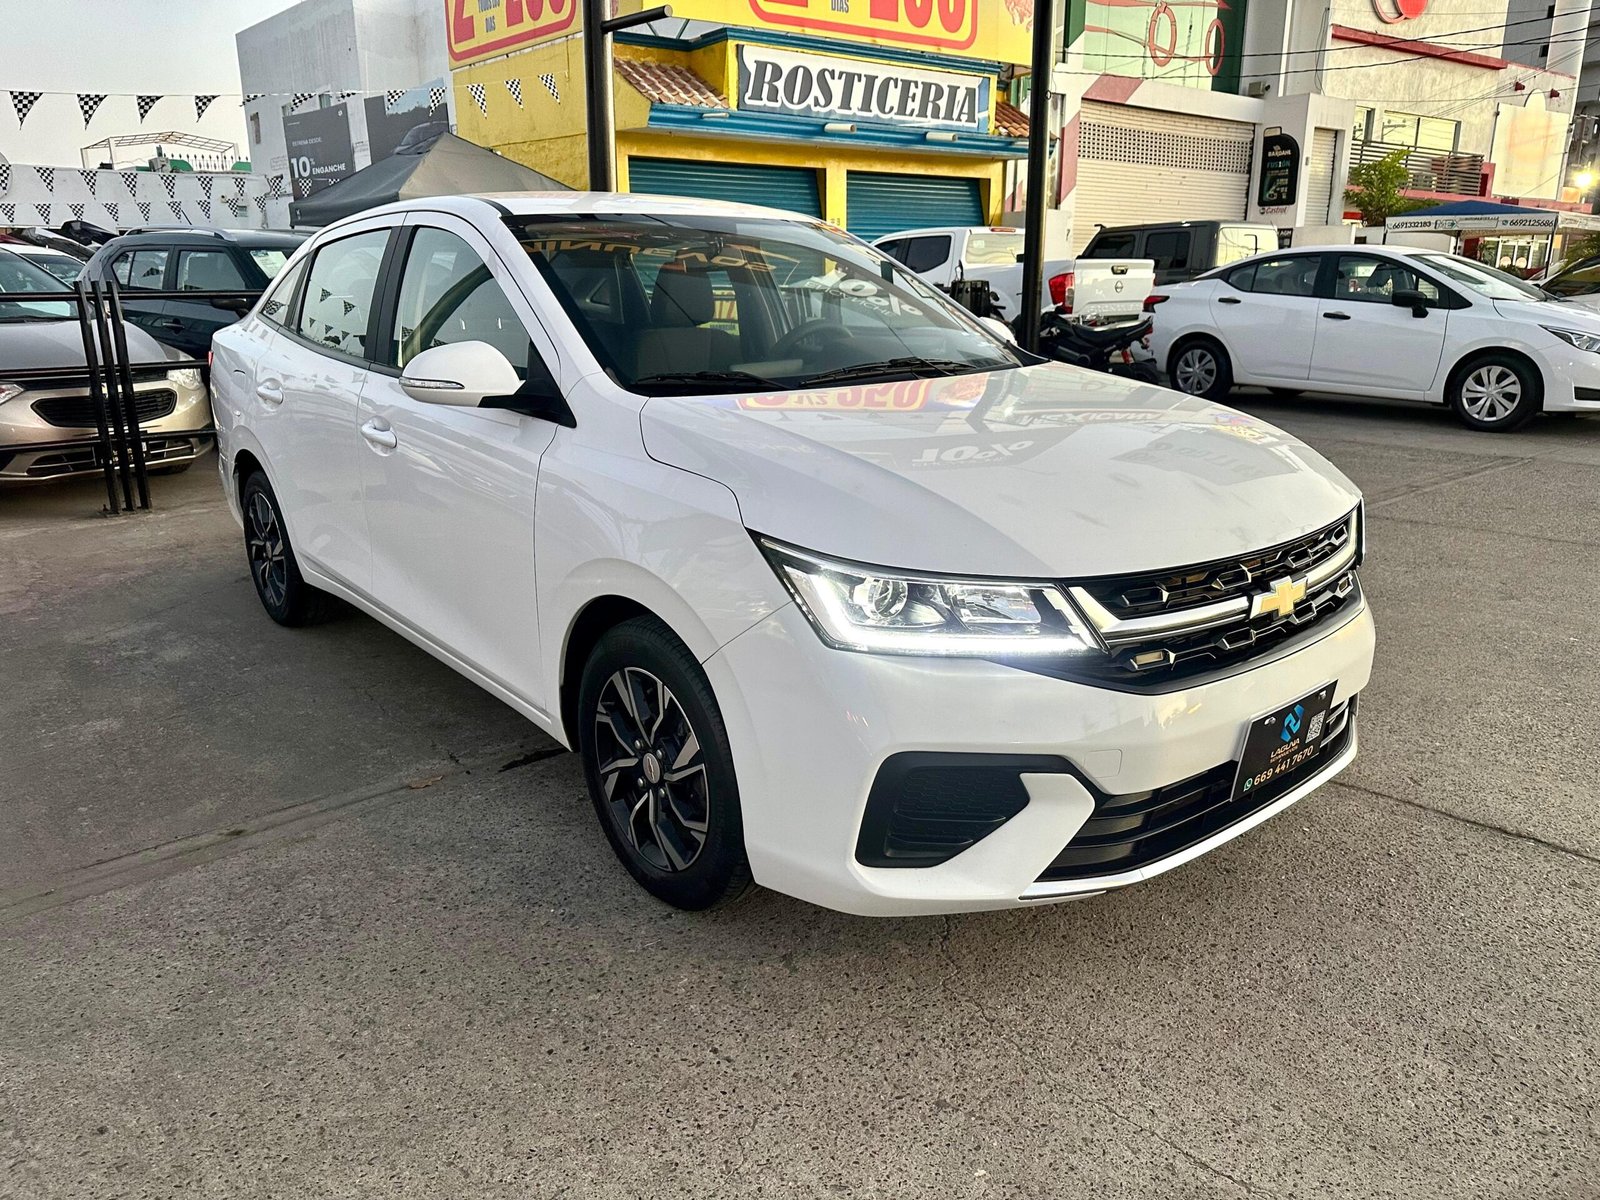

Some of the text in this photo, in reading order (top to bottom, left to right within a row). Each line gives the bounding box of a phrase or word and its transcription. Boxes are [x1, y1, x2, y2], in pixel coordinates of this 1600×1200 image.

[748, 60, 977, 123] ROSTICERIA
[312, 163, 346, 175] ENGANCHE
[1509, 218, 1554, 227] 6692125686
[1270, 738, 1299, 757] LAGUNA
[1254, 745, 1313, 786] 669 441 7670
